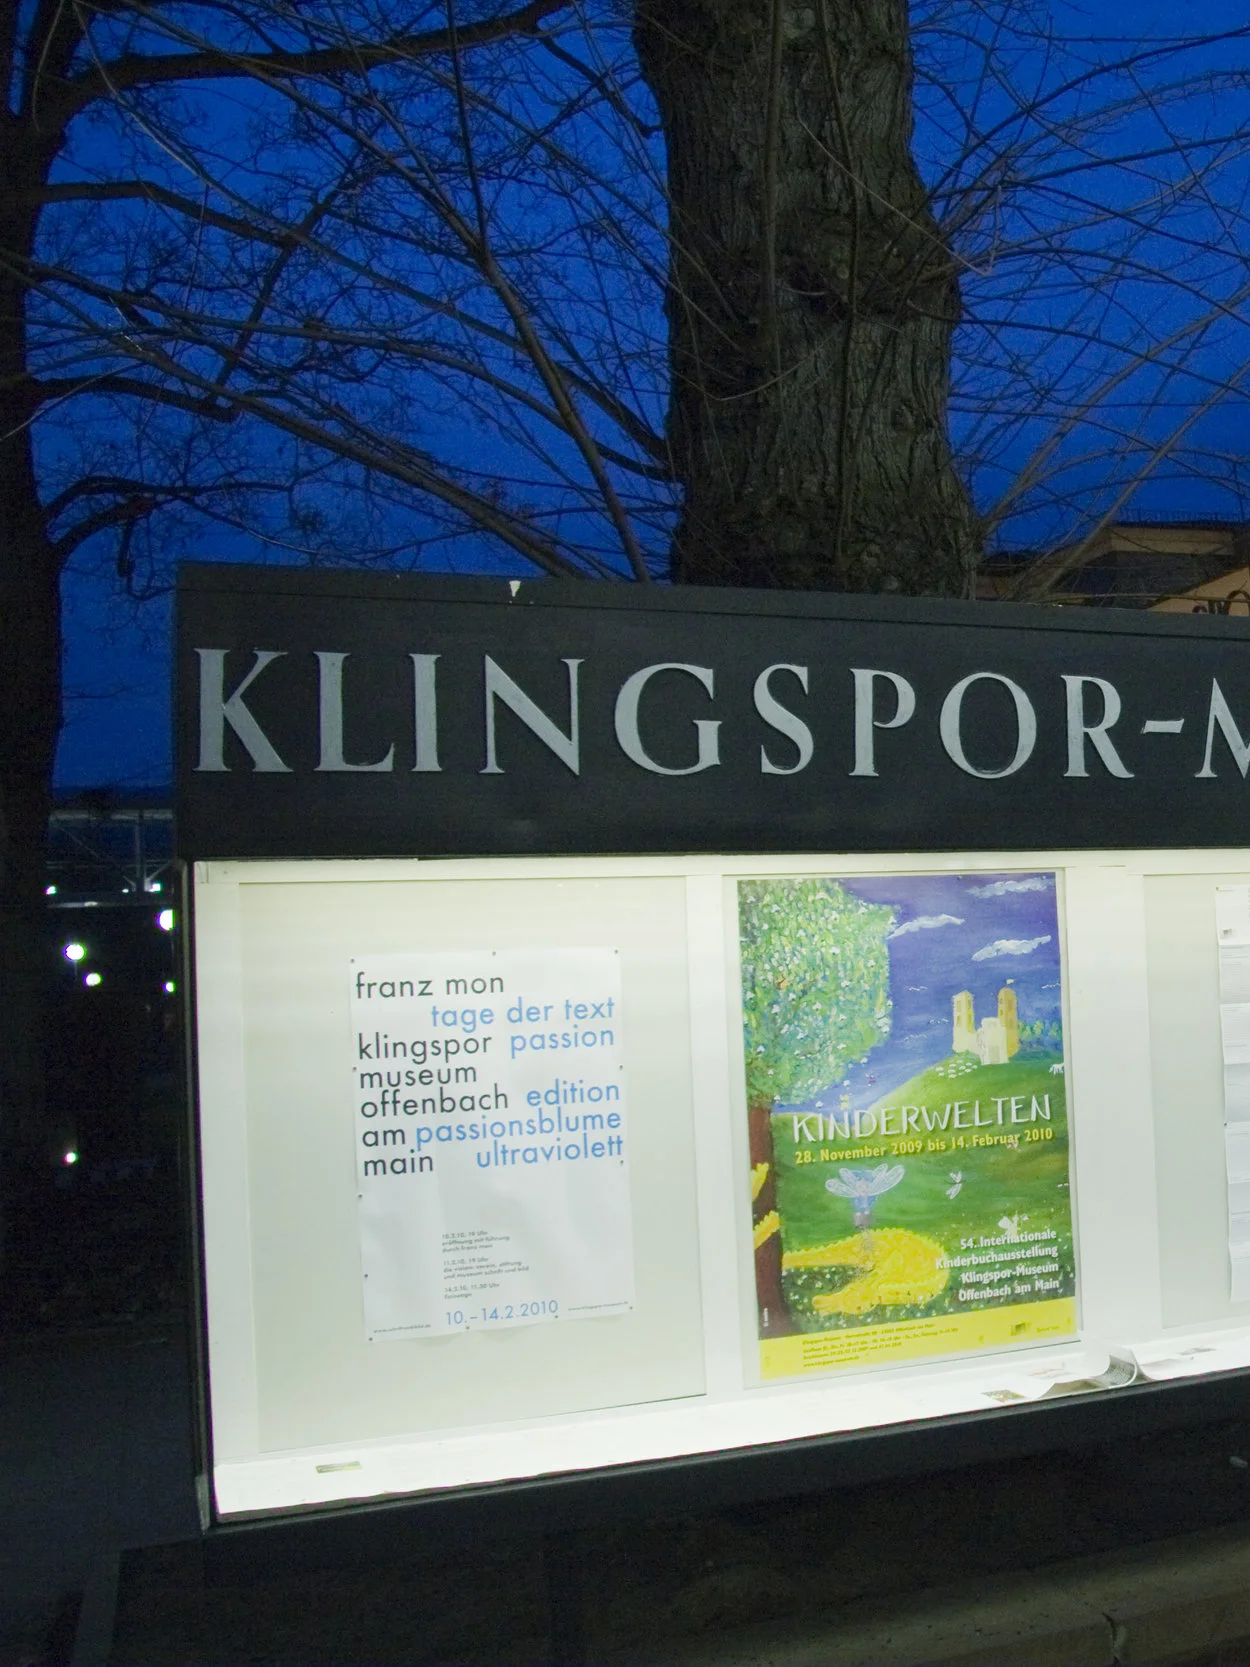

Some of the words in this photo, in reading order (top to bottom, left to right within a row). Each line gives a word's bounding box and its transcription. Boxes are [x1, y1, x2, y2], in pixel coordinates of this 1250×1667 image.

[356, 971, 433, 999] franz
[446, 976, 504, 995] mon
[431, 1005, 495, 1033] tage
[506, 996, 554, 1023] der
[564, 997, 615, 1021] text
[358, 1031, 492, 1065] klingspor
[510, 1024, 615, 1059] passion
[359, 1066, 477, 1089] museum
[360, 1083, 509, 1118] offenbach
[526, 1078, 620, 1107] edition
[416, 1106, 622, 1152] passionsblume
[792, 1094, 1051, 1143] KINDERWELTEN
[362, 1128, 406, 1147] am
[476, 1133, 623, 1168] ultraviolett
[795, 1151, 817, 1164] 28.
[820, 1146, 886, 1162] November
[891, 1141, 923, 1156] 2009
[928, 1138, 946, 1152] bis
[951, 1136, 969, 1150] 14.
[972, 1132, 1020, 1147] Februar
[1024, 1128, 1053, 1142] 2010
[363, 1149, 434, 1177] main
[979, 1229, 1057, 1247] Internationale
[935, 1245, 1058, 1269] Kinderbuchausstellung
[960, 1263, 1059, 1285] Klingspor-Museum
[958, 1284, 1011, 1302] Offenbach
[1014, 1283, 1031, 1295] am
[1035, 1278, 1060, 1292] Main
